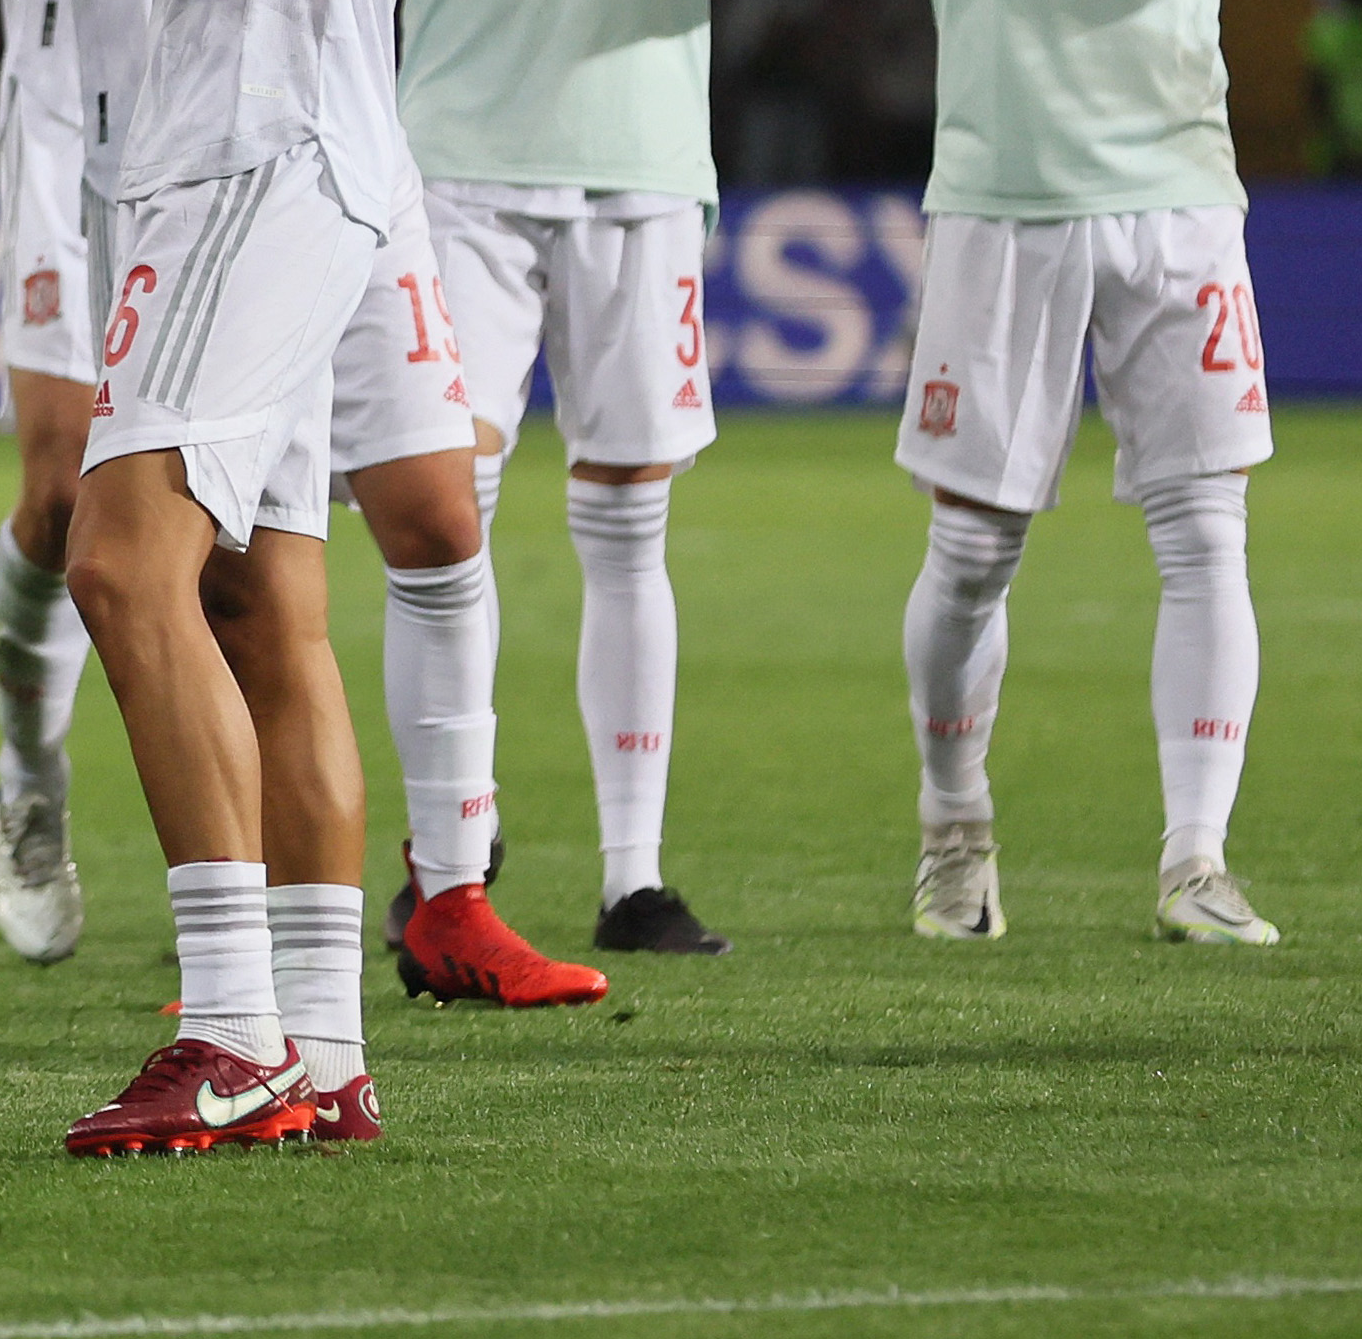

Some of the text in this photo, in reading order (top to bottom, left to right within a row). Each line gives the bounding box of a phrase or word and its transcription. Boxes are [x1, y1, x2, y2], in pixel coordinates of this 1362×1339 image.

[104, 264, 157, 367] 6
[675, 276, 699, 367] 3
[1196, 281, 1264, 373] 20
